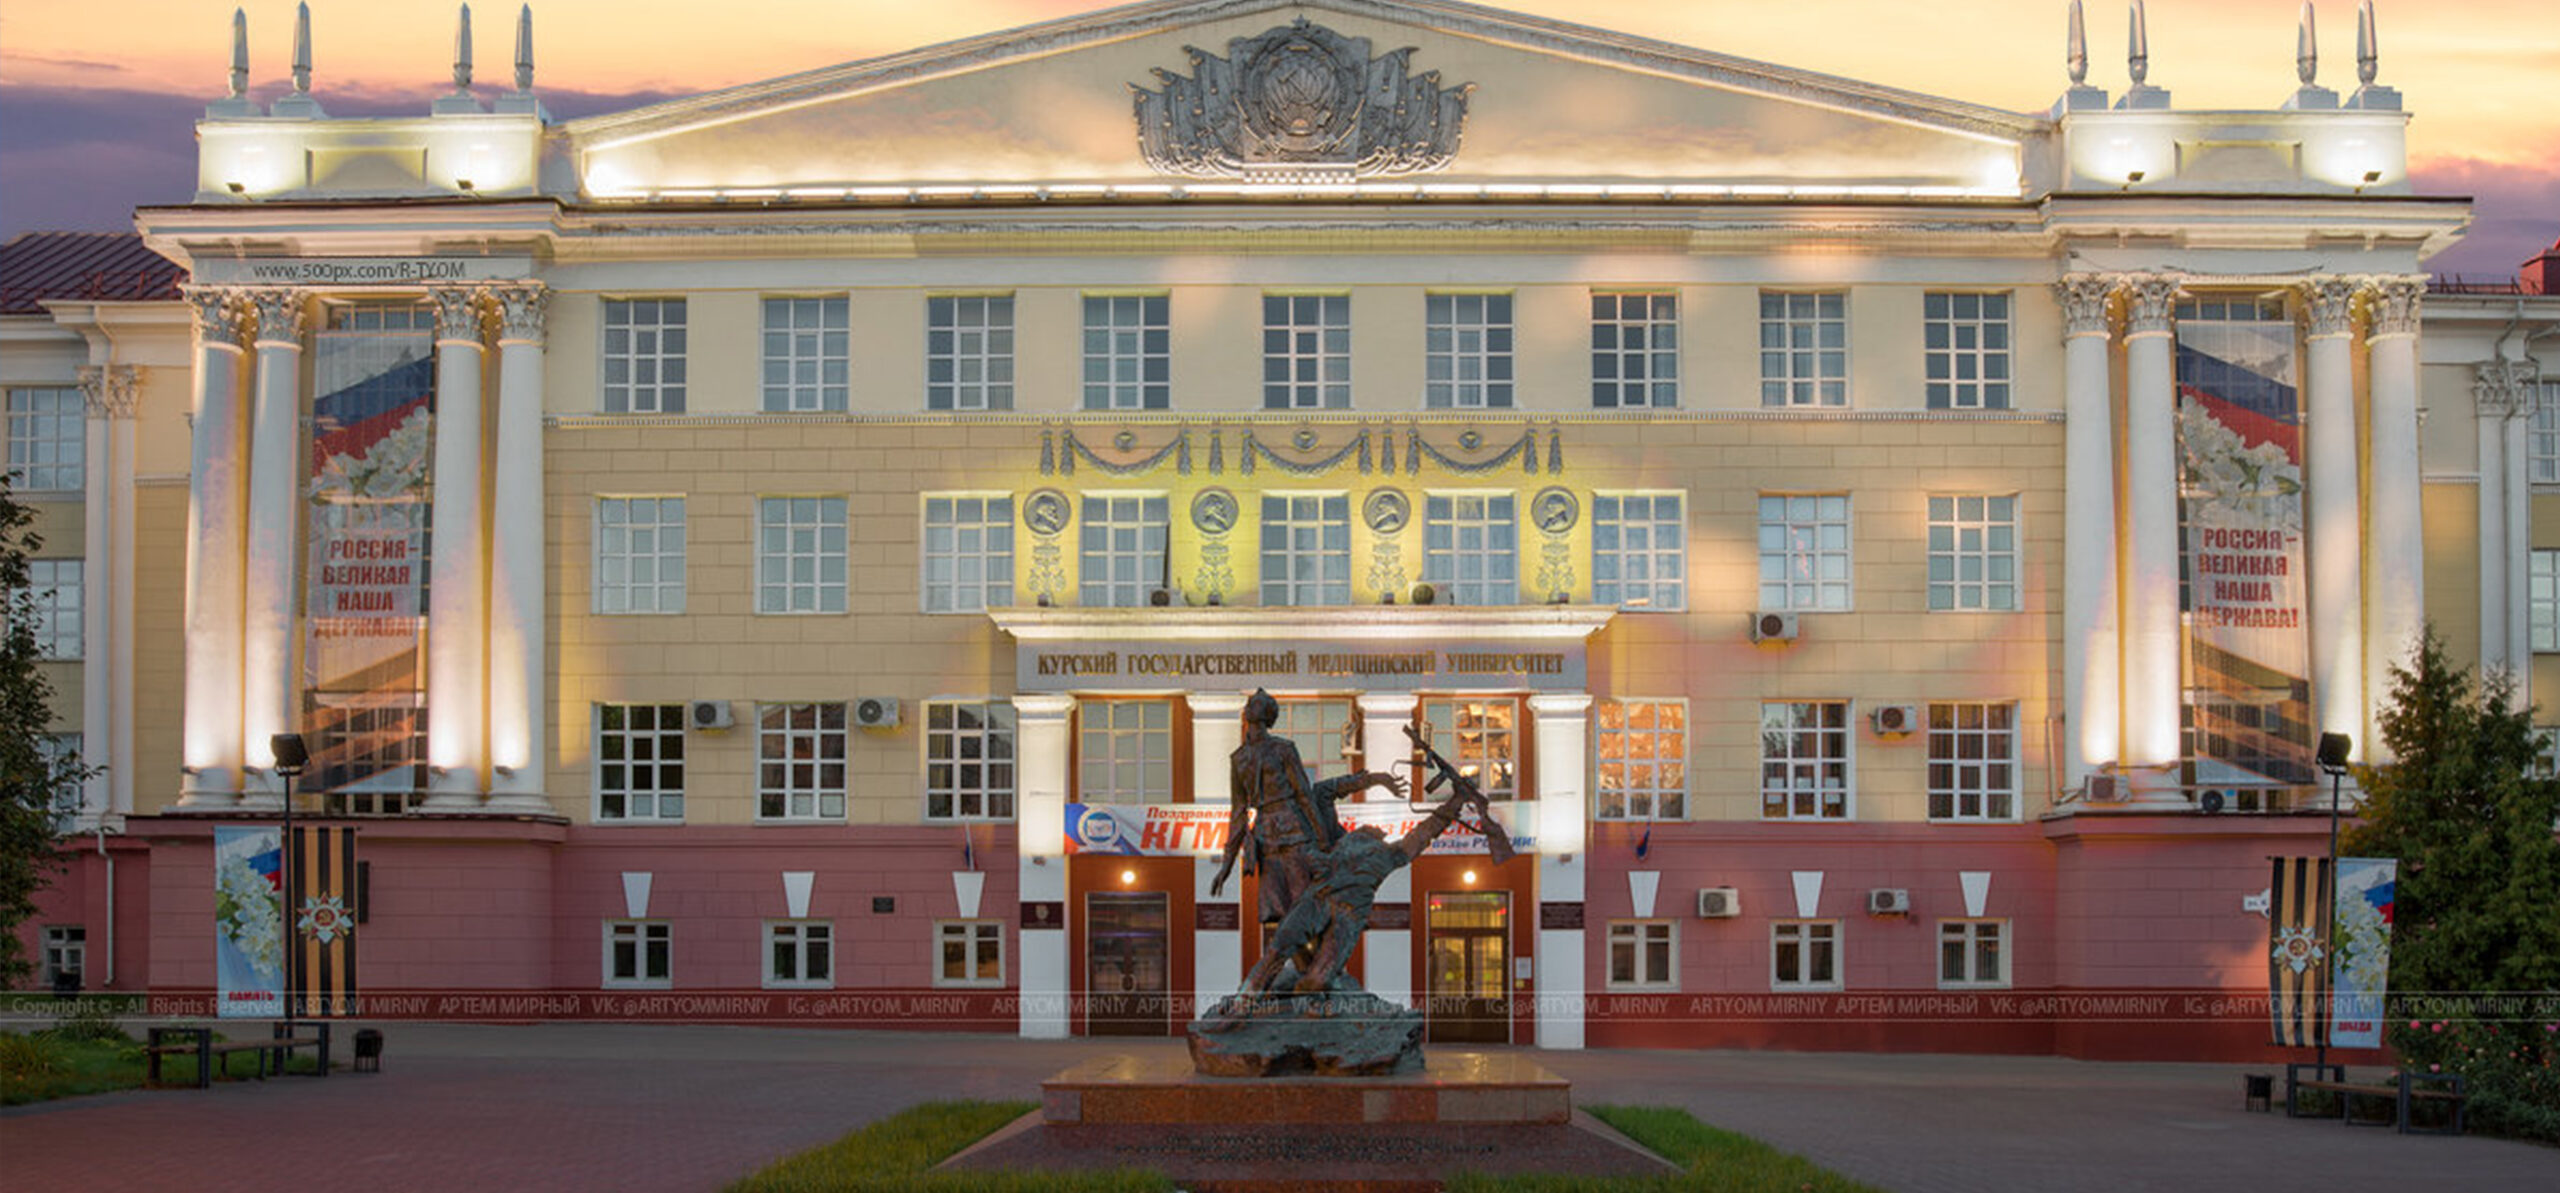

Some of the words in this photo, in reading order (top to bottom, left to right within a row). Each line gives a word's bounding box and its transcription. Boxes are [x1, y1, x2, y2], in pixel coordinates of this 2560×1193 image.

[322, 565, 410, 585] ВЕЛИКАЯ
[2198, 554, 2287, 576] ВЕЛИКАЯ
[337, 592, 393, 611] НАША
[2215, 581, 2272, 602] НАША
[1037, 652, 1117, 675] КУРСКИЙ
[1127, 651, 1298, 677] ГОСУДАРСТВЕННЫЙ
[1308, 651, 1436, 677] МЕДИЦИНСКИЙ
[1446, 653, 1565, 674] УНИВЕРСИТЕТ
[1147, 806, 1233, 821] Поздравля
[1140, 821, 1232, 849] КГМ
[1472, 836, 1537, 849] РОИИ!
